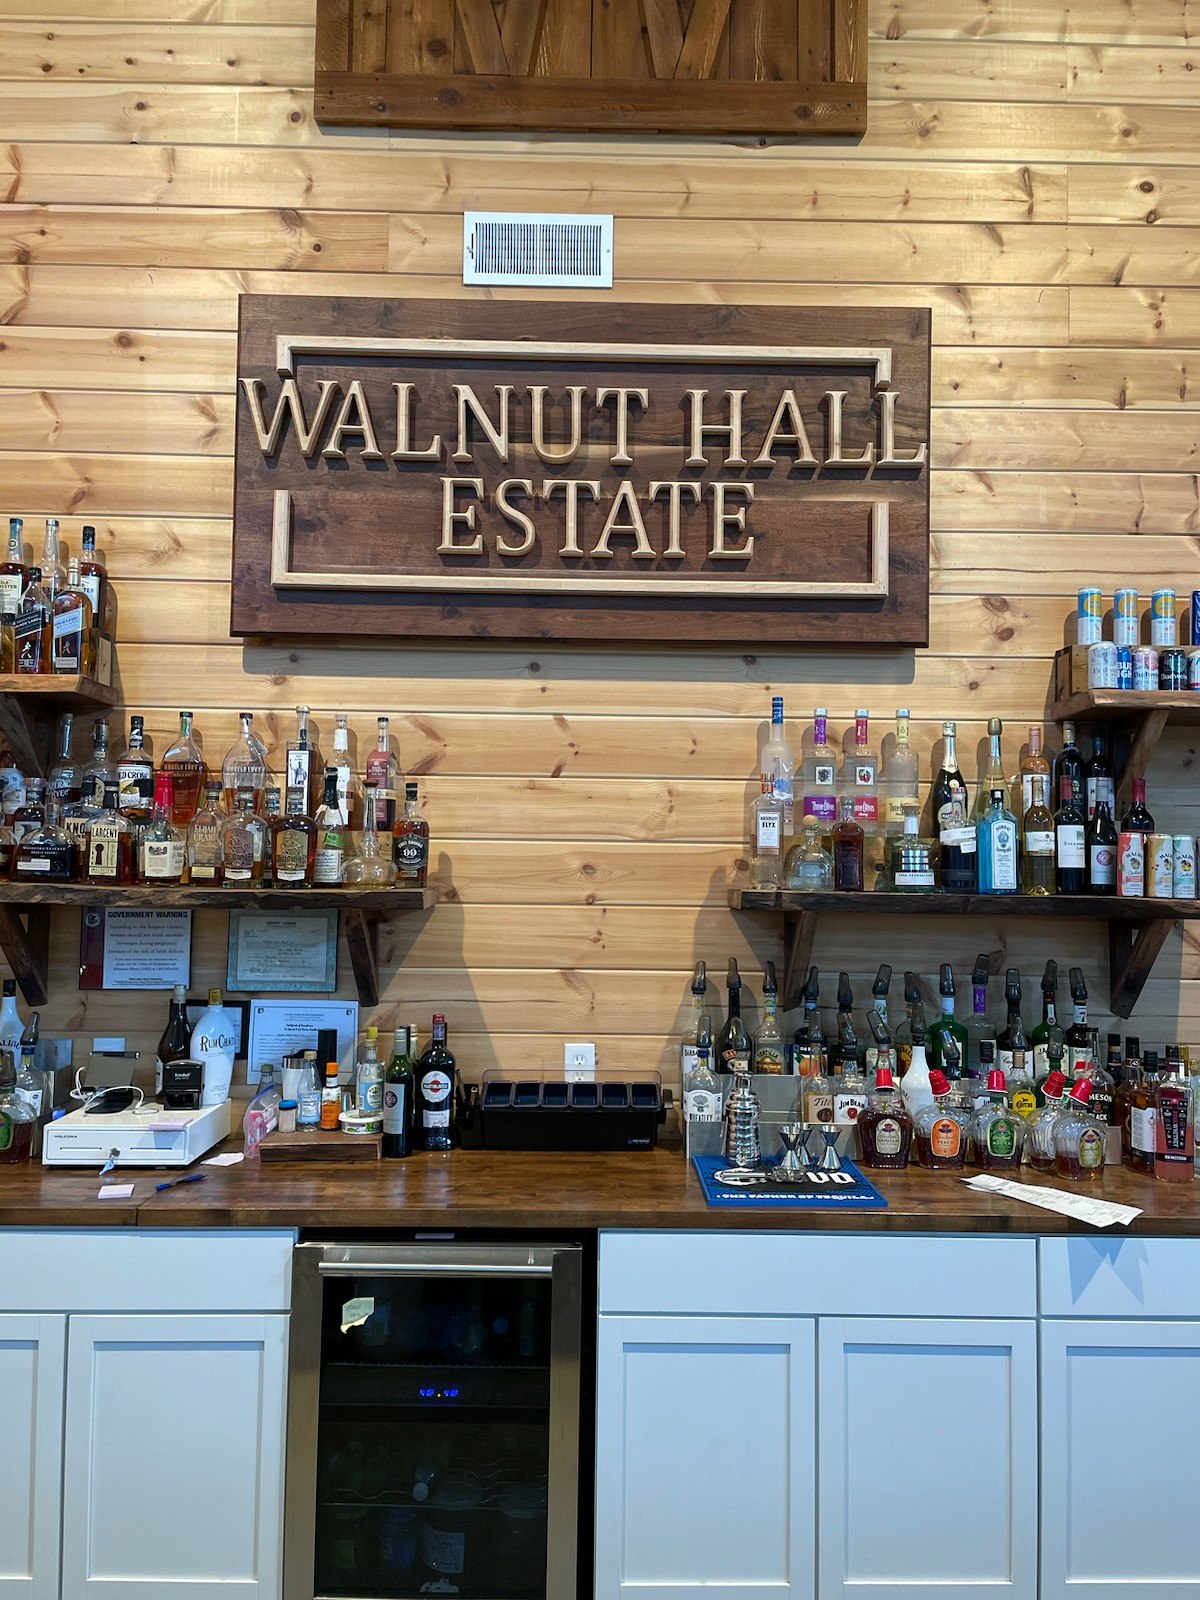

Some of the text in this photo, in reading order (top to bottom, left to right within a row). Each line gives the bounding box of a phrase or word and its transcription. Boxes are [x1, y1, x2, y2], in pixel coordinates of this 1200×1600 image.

[238, 377, 928, 471] WALNUT HALL
[437, 477, 756, 560] ESTATE
[127, 771, 149, 779] CROW
[66, 821, 86, 834] KNO
[402, 848, 418, 857] 99
[107, 911, 188, 919] GOVERNMENT WARNING
[1088, 1093, 1113, 1103] MESON
[838, 1100, 850, 1110] JIM
